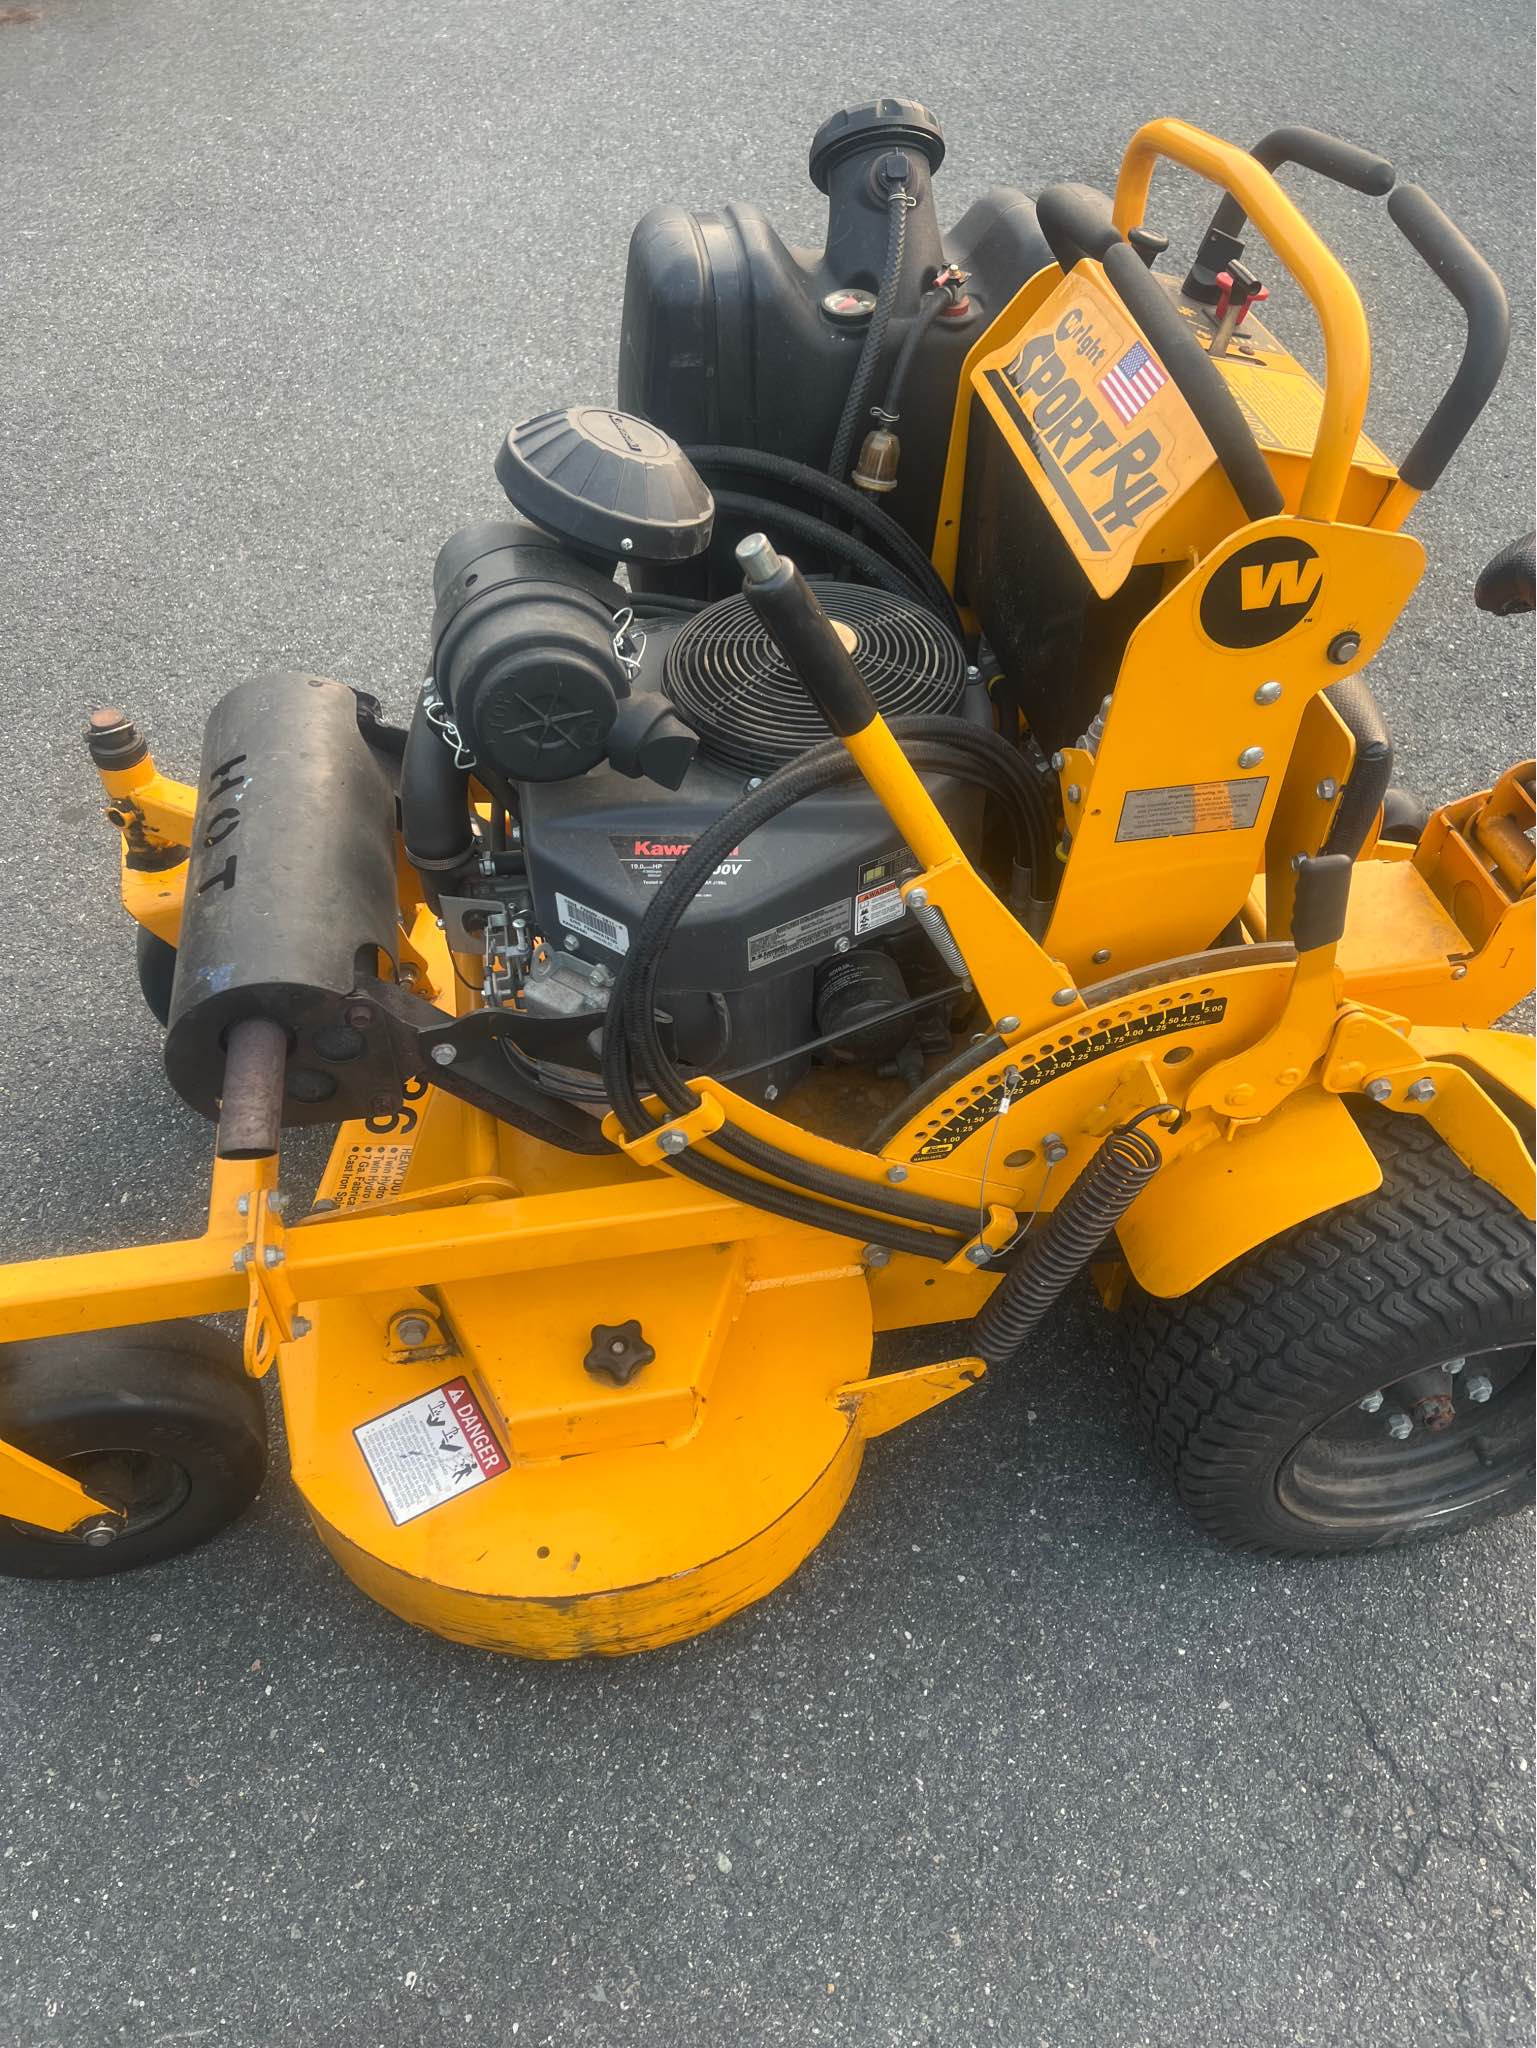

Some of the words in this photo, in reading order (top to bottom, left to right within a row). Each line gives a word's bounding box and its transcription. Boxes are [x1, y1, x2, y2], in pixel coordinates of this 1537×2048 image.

[1001, 333, 1119, 475] SPORT
[1241, 557, 1324, 611] W
[199, 755, 247, 894] HOT
[1204, 1005, 1223, 1014] 5.00
[1160, 1016, 1179, 1025] 4.50
[1181, 1014, 1201, 1023] 4.75
[1147, 1023, 1167, 1032] 4.25
[1124, 1029, 1144, 1037] 4.00
[1105, 1036, 1125, 1045] 3.75
[1085, 1044, 1105, 1053] 3.50
[1070, 1053, 1089, 1062] 3.25
[1053, 1061, 1072, 1070] 3.00
[1036, 1069, 1056, 1077] 2.75
[1022, 1079, 1040, 1087] 2.50
[1005, 1087, 1024, 1096] 225
[967, 1116, 984, 1124] 1.50
[955, 1125, 973, 1133] 1.25
[344, 1154, 358, 1172] Cast
[370, 1155, 385, 1173] Twin
[384, 1155, 398, 1173] Twin
[339, 1174, 353, 1190] Iron
[362, 1175, 379, 1199] Hydro
[376, 1175, 392, 1199] Hydro
[346, 1176, 365, 1208] Fabrica
[456, 1402, 500, 1470] DANGER
